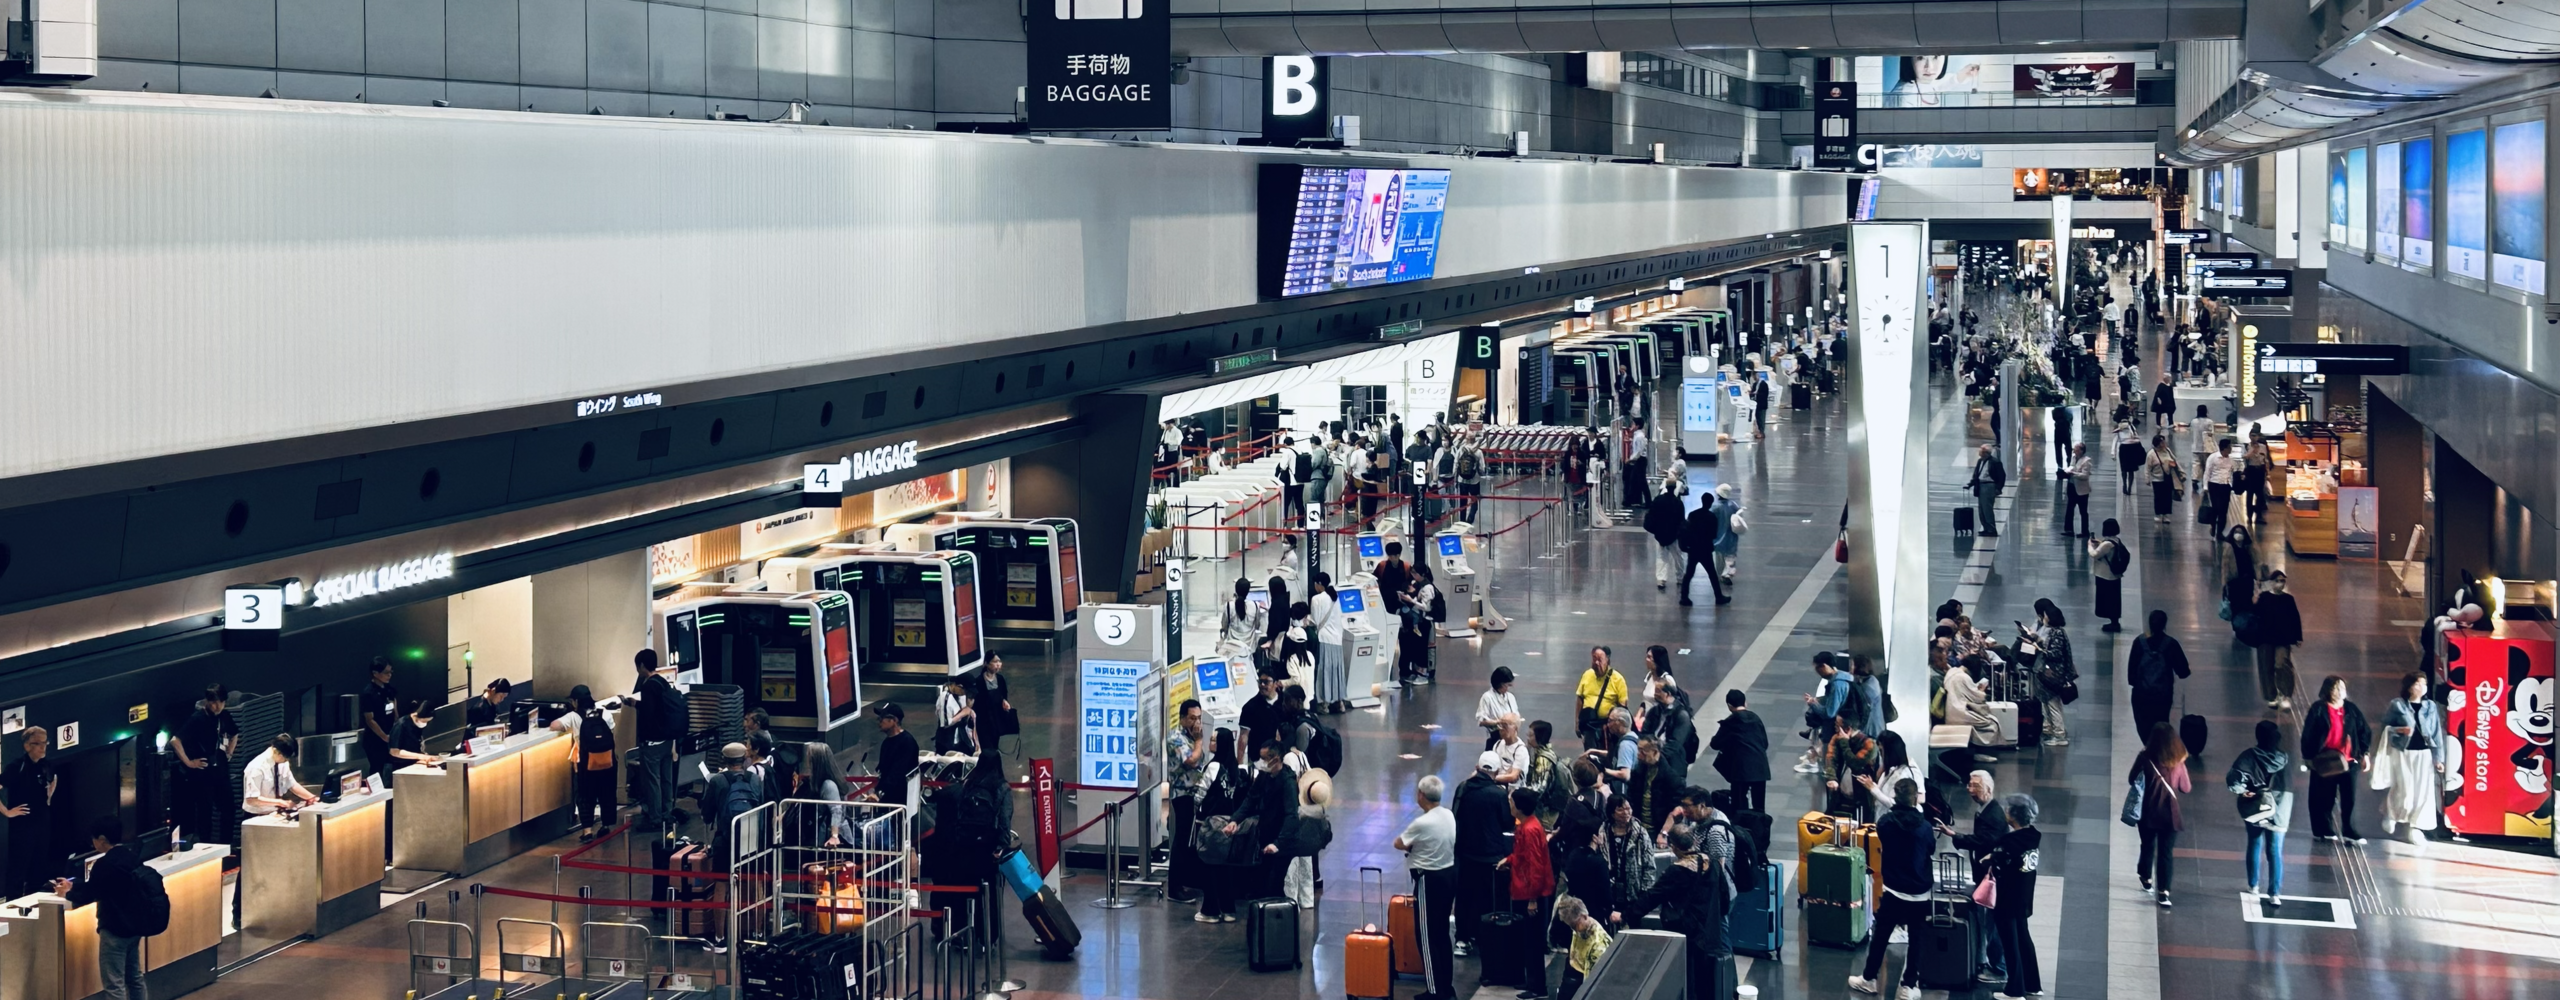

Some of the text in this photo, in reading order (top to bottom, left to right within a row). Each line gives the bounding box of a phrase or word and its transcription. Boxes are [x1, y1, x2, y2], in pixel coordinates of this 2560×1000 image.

[1066, 53, 1131, 76] 手荷物
[1047, 84, 1151, 102] BAGGAGE
[1273, 55, 1317, 115] B
[1880, 245, 1889, 279] 1
[1579, 300, 1586, 311] 6
[1477, 336, 1492, 358] B
[1422, 359, 1435, 379] B
[2242, 339, 2258, 408] Information
[853, 440, 918, 480] BAGGAGE
[815, 468, 830, 488] 4
[312, 552, 453, 608] SPECIAL BAGGAGE
[241, 594, 261, 624] 3
[1108, 614, 1123, 639] 3
[2466, 676, 2504, 792] Disney store
[1039, 765, 1053, 835] 入口 ENTRANCE
